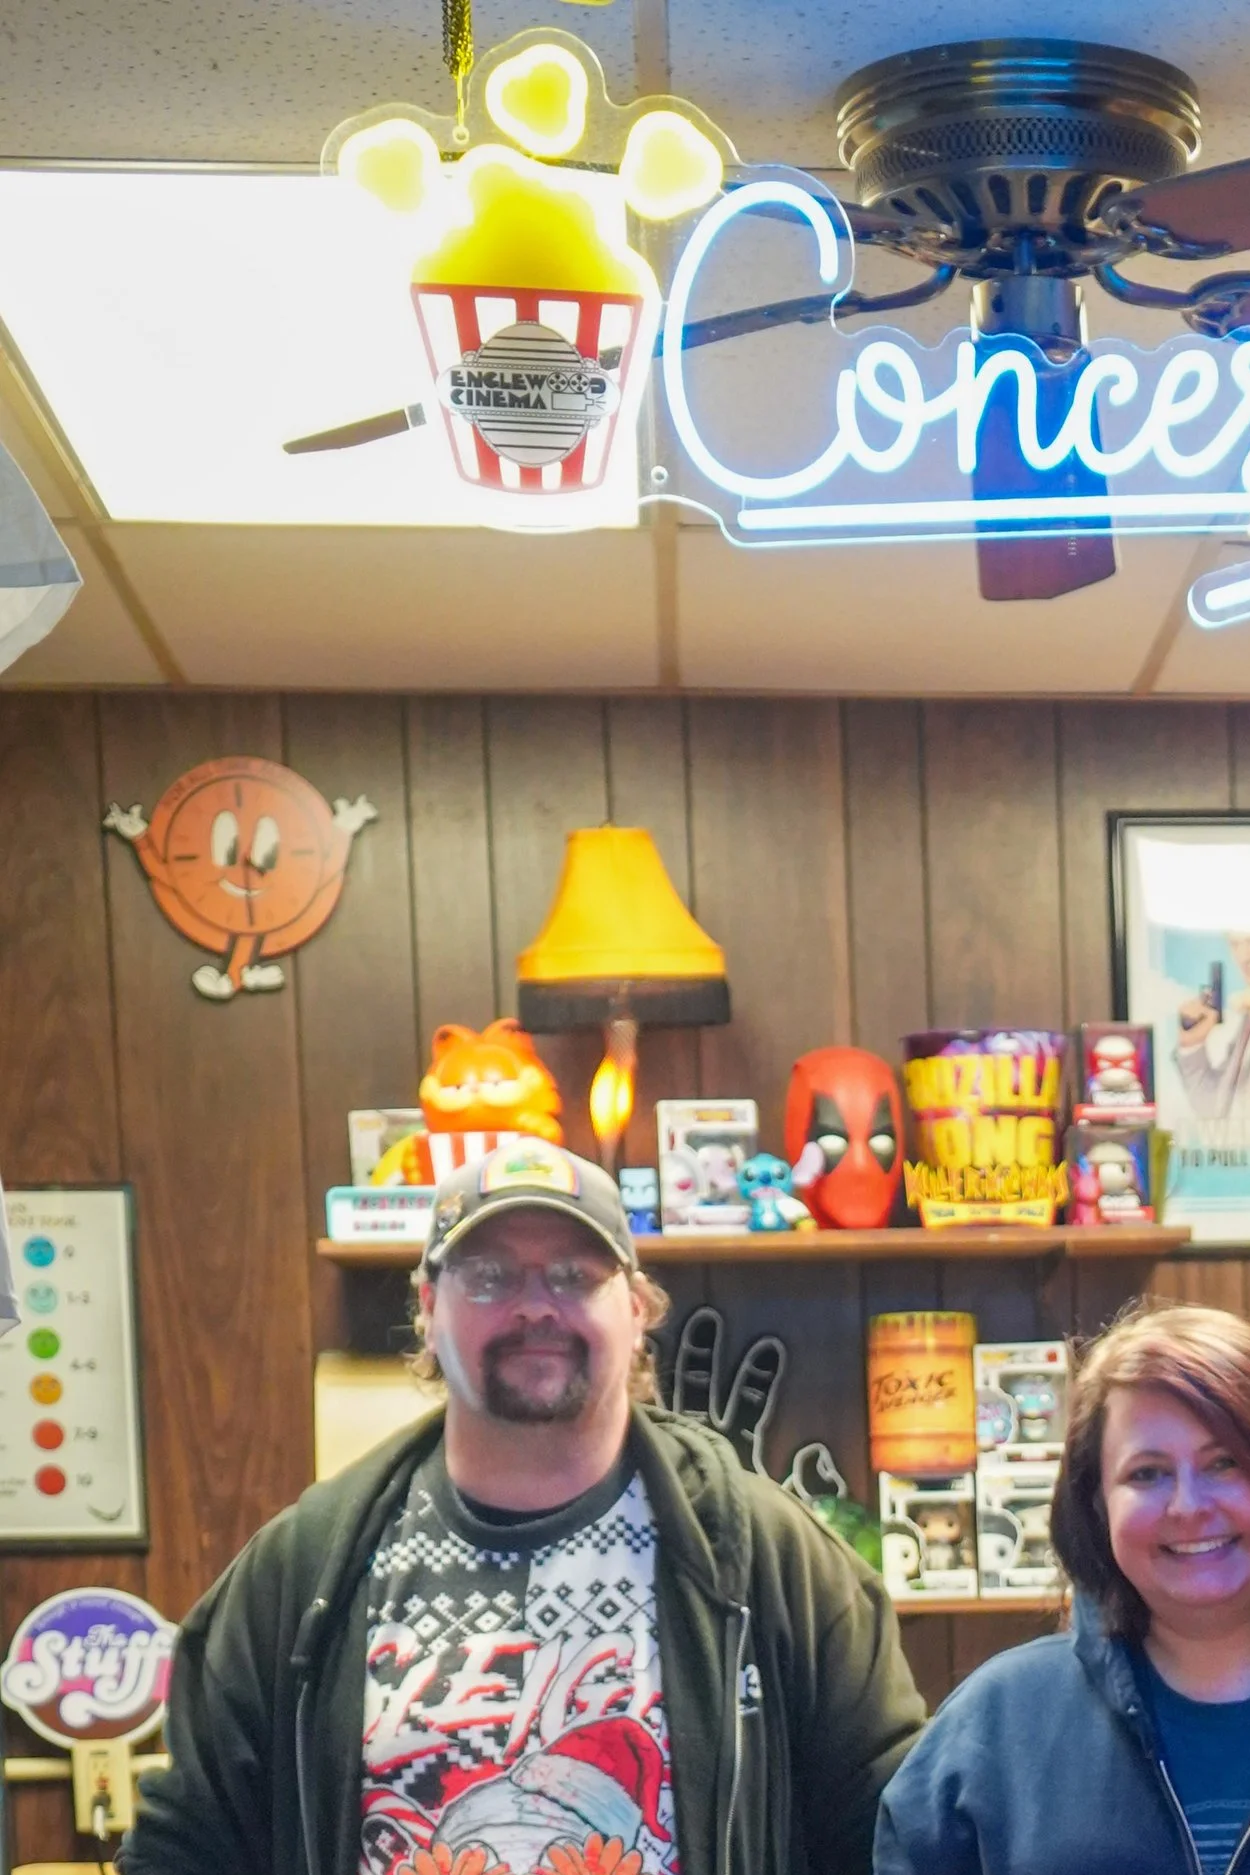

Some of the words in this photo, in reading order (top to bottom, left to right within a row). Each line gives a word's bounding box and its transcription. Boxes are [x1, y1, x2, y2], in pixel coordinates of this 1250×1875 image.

[450, 388, 547, 410] CINEMA
[873, 1370, 954, 1404] TOXIC
[5, 1629, 177, 1729] Stuff
